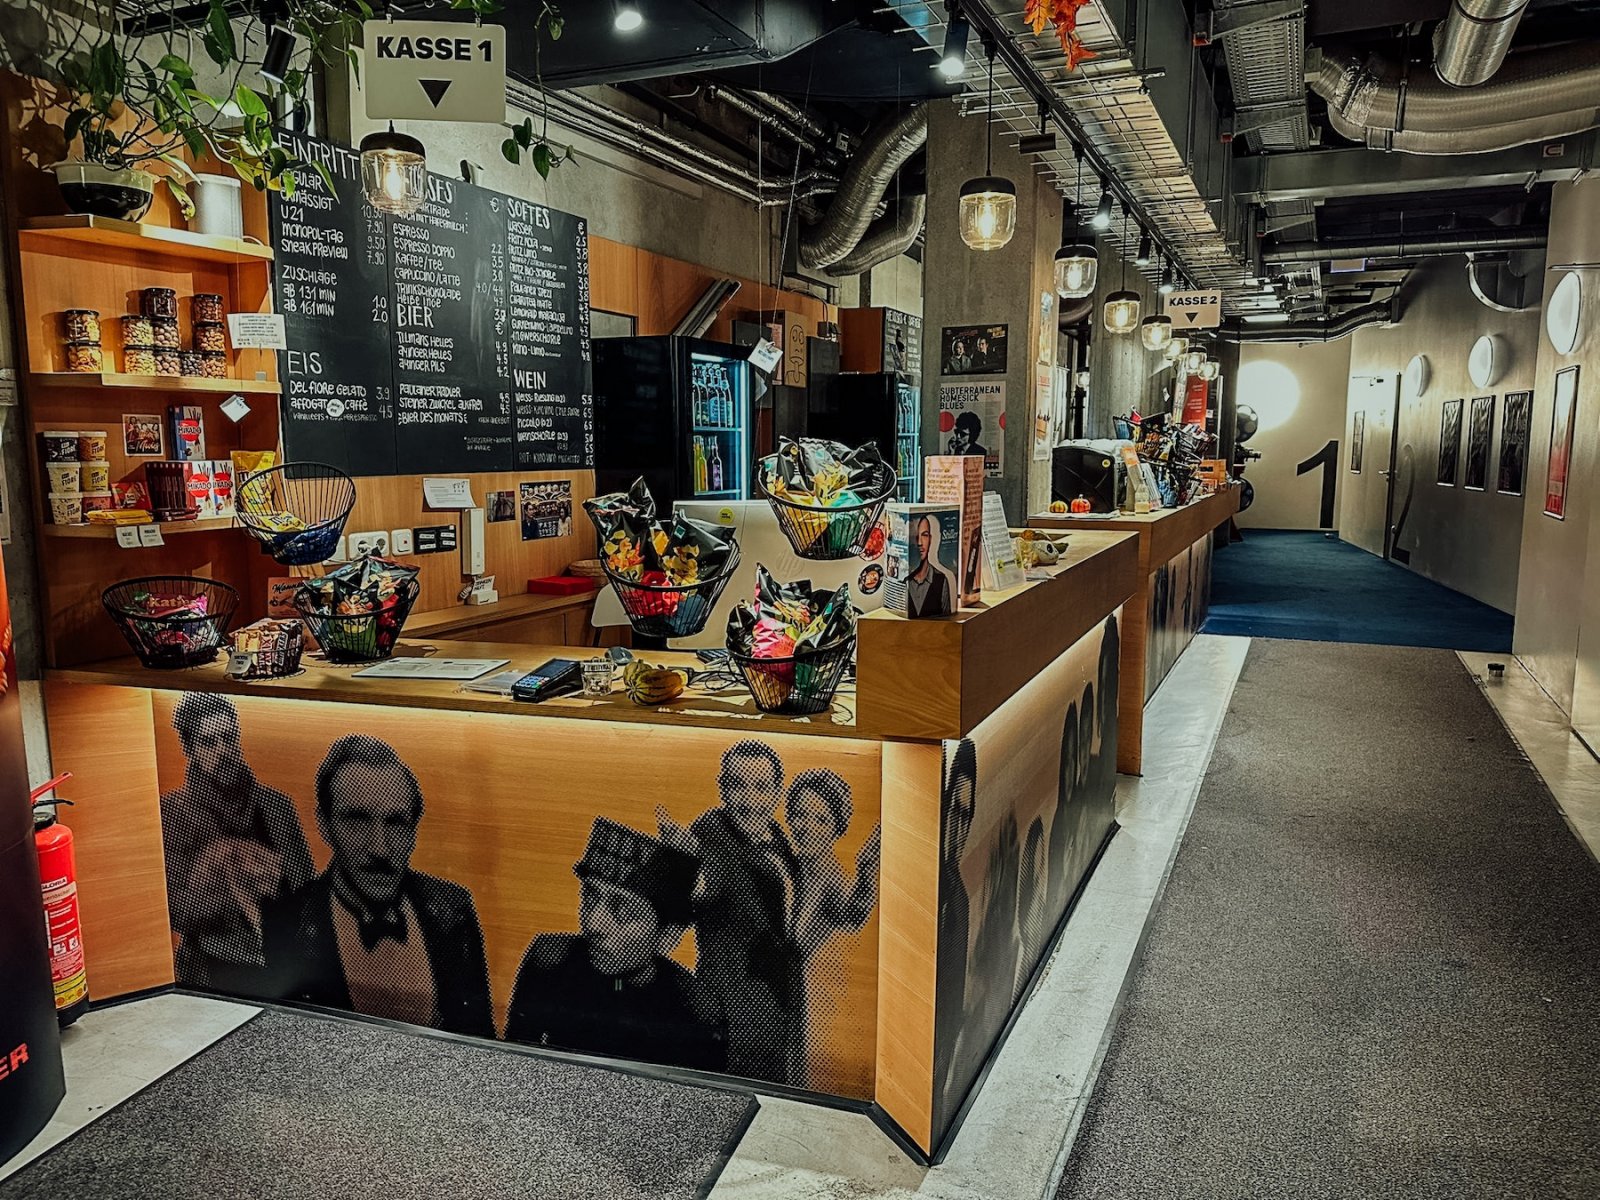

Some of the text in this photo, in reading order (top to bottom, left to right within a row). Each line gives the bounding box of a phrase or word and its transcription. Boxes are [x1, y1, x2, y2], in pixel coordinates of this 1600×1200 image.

[377, 36, 492, 62] KASSE 1
[507, 197, 550, 230] SOFTES
[393, 222, 430, 241] ESPRESSO
[394, 236, 455, 259] ESPRESSO DOPPIO
[282, 265, 337, 286] ZUSCHLÄGE
[299, 286, 317, 300] 131
[395, 282, 461, 301] TRINKSCHOKOLADE
[299, 301, 316, 316] 161
[1169, 295, 1218, 307] KASSE 2
[397, 303, 434, 328] BIER
[430, 336, 454, 349] HELLES
[287, 350, 323, 376] EIS
[431, 360, 445, 373] PILS
[513, 368, 546, 390] WEIN
[290, 380, 367, 397] DEL FIORE GELATO
[940, 385, 1001, 395] SUBTERRANEAN
[290, 397, 328, 411] AFFOGAT
[940, 393, 979, 403] HOMESICK
[940, 401, 965, 410] BLUES
[403, 412, 419, 424] BIER
[419, 412, 433, 424] DES
[178, 426, 201, 435] MIKADO
[187, 481, 212, 490] MIKADO
[1296, 440, 1339, 529] 1
